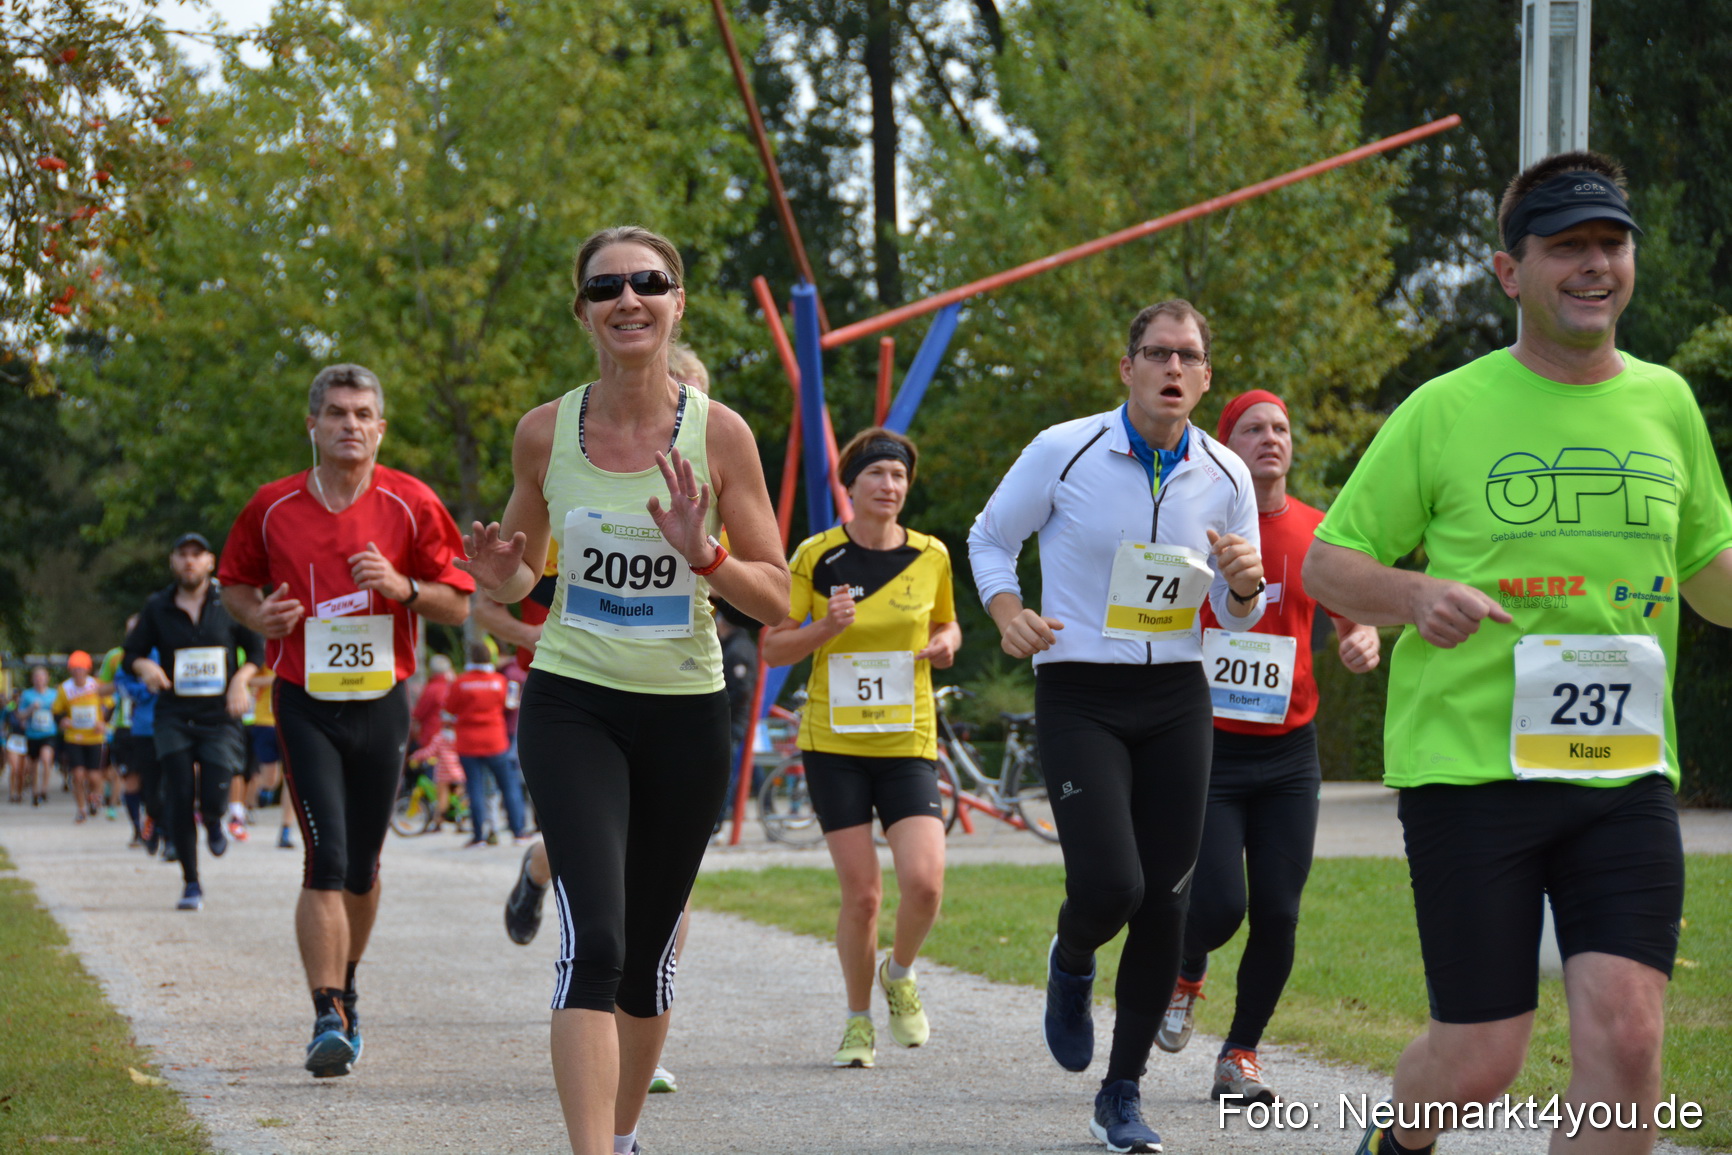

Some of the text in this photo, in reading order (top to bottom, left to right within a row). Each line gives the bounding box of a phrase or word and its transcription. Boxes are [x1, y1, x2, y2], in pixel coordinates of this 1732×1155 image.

[614, 525, 662, 539] BOCK
[1490, 529, 1537, 543] Gebäude-
[1540, 528, 1557, 538] und
[1558, 528, 1661, 541] Automatisierungstechnik
[583, 547, 677, 591] 2099
[830, 585, 864, 600] Bgit
[1145, 574, 1180, 604] 74
[1498, 575, 1588, 598] MERZ
[599, 598, 654, 617] Manuela
[1499, 590, 1568, 610] Reisen
[1137, 613, 1173, 625] Thomas
[327, 643, 374, 668] 235
[1578, 650, 1629, 662] BOCK
[1213, 657, 1280, 689] 2018
[857, 676, 884, 702] 51
[1228, 693, 1261, 707] Robert
[1550, 682, 1632, 727] 237
[861, 709, 886, 720] Birgit
[1569, 742, 1612, 759] Klaus
